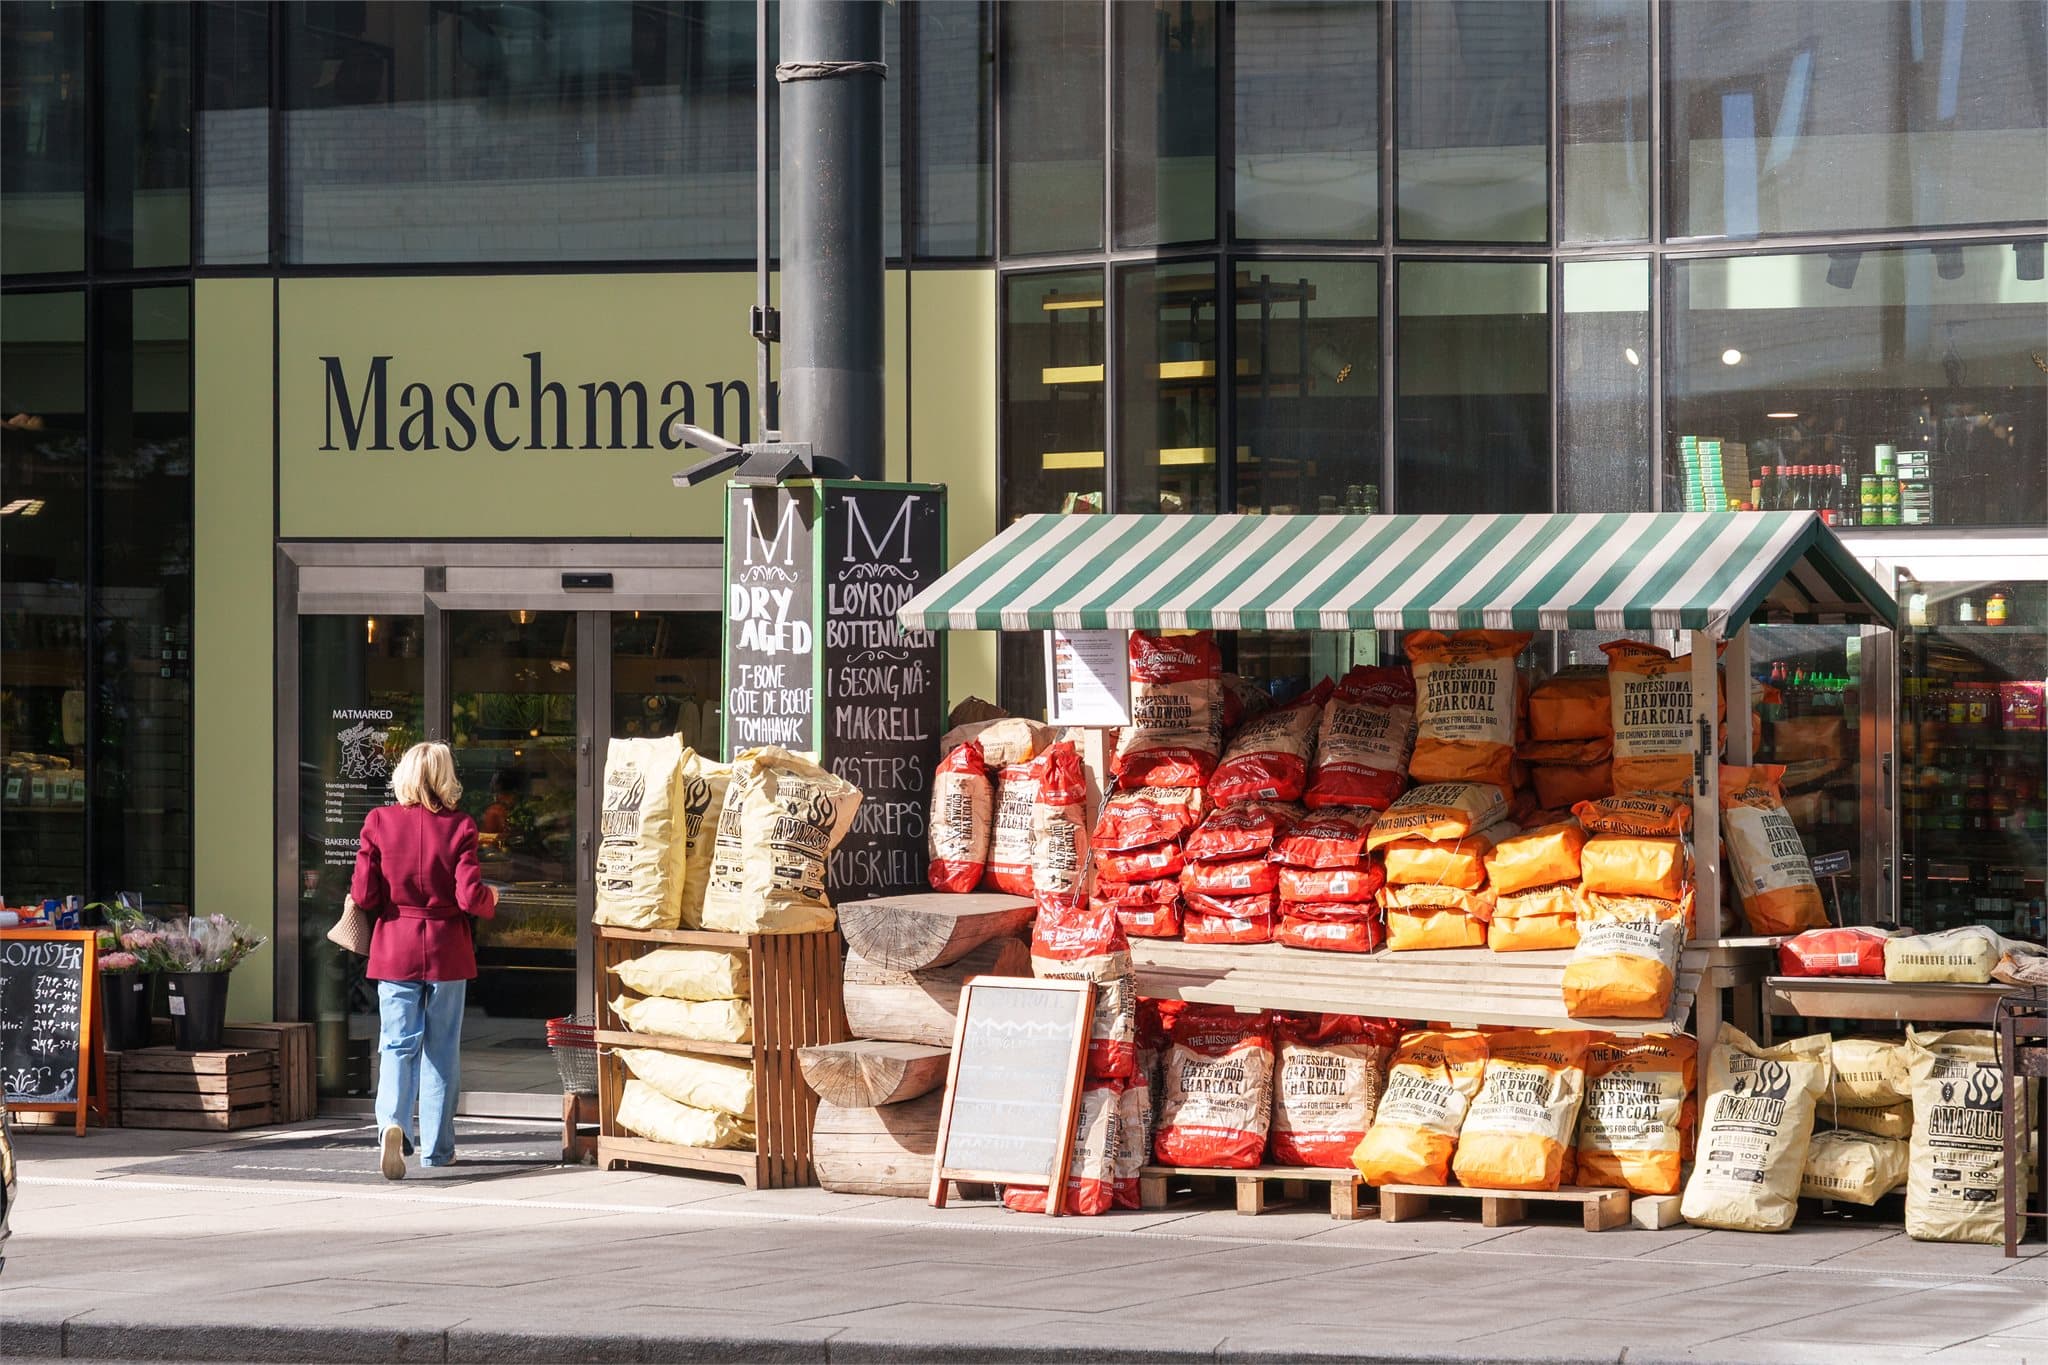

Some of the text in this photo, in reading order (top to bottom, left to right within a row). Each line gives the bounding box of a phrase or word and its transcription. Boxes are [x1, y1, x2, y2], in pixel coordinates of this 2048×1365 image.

[743, 498, 799, 566] M
[842, 495, 920, 563] M
[729, 584, 793, 624] DRY
[736, 619, 812, 656] AGED
[738, 665, 786, 688] T-BONE
[827, 668, 832, 697] I
[839, 665, 899, 702] SESONG
[1427, 668, 1498, 683] PROFESSIONAL
[1428, 681, 1496, 698] HARDWOOD
[1624, 681, 1693, 694] PROFESSIONA
[763, 690, 778, 715] DE
[780, 688, 813, 715] BOEUF
[1428, 694, 1494, 713] CHARCOAL
[1625, 693, 1693, 710] HARDWOOD
[333, 709, 393, 719] MATMARKED
[1624, 709, 1693, 726] CHARCOAL
[735, 717, 803, 744] TOMAHAWK
[836, 705, 928, 741] MAKRELL
[1393, 815, 1427, 828] MISSING
[325, 838, 350, 846] BAKERI
[1188, 1036, 1204, 1047] THE
[1592, 1049, 1609, 1061] THE
[1181, 1079, 1241, 1095] CHARCOAL
[1390, 1078, 1454, 1096] HARDWOOD
[1592, 1079, 1662, 1095] PROFESSIONAL
[1588, 1106, 1659, 1121] CHARCOAL
[1714, 1094, 1786, 1126] AMAZULU
[1929, 1105, 2003, 1141] AMAZULU
[1968, 1170, 1997, 1180] 100%
